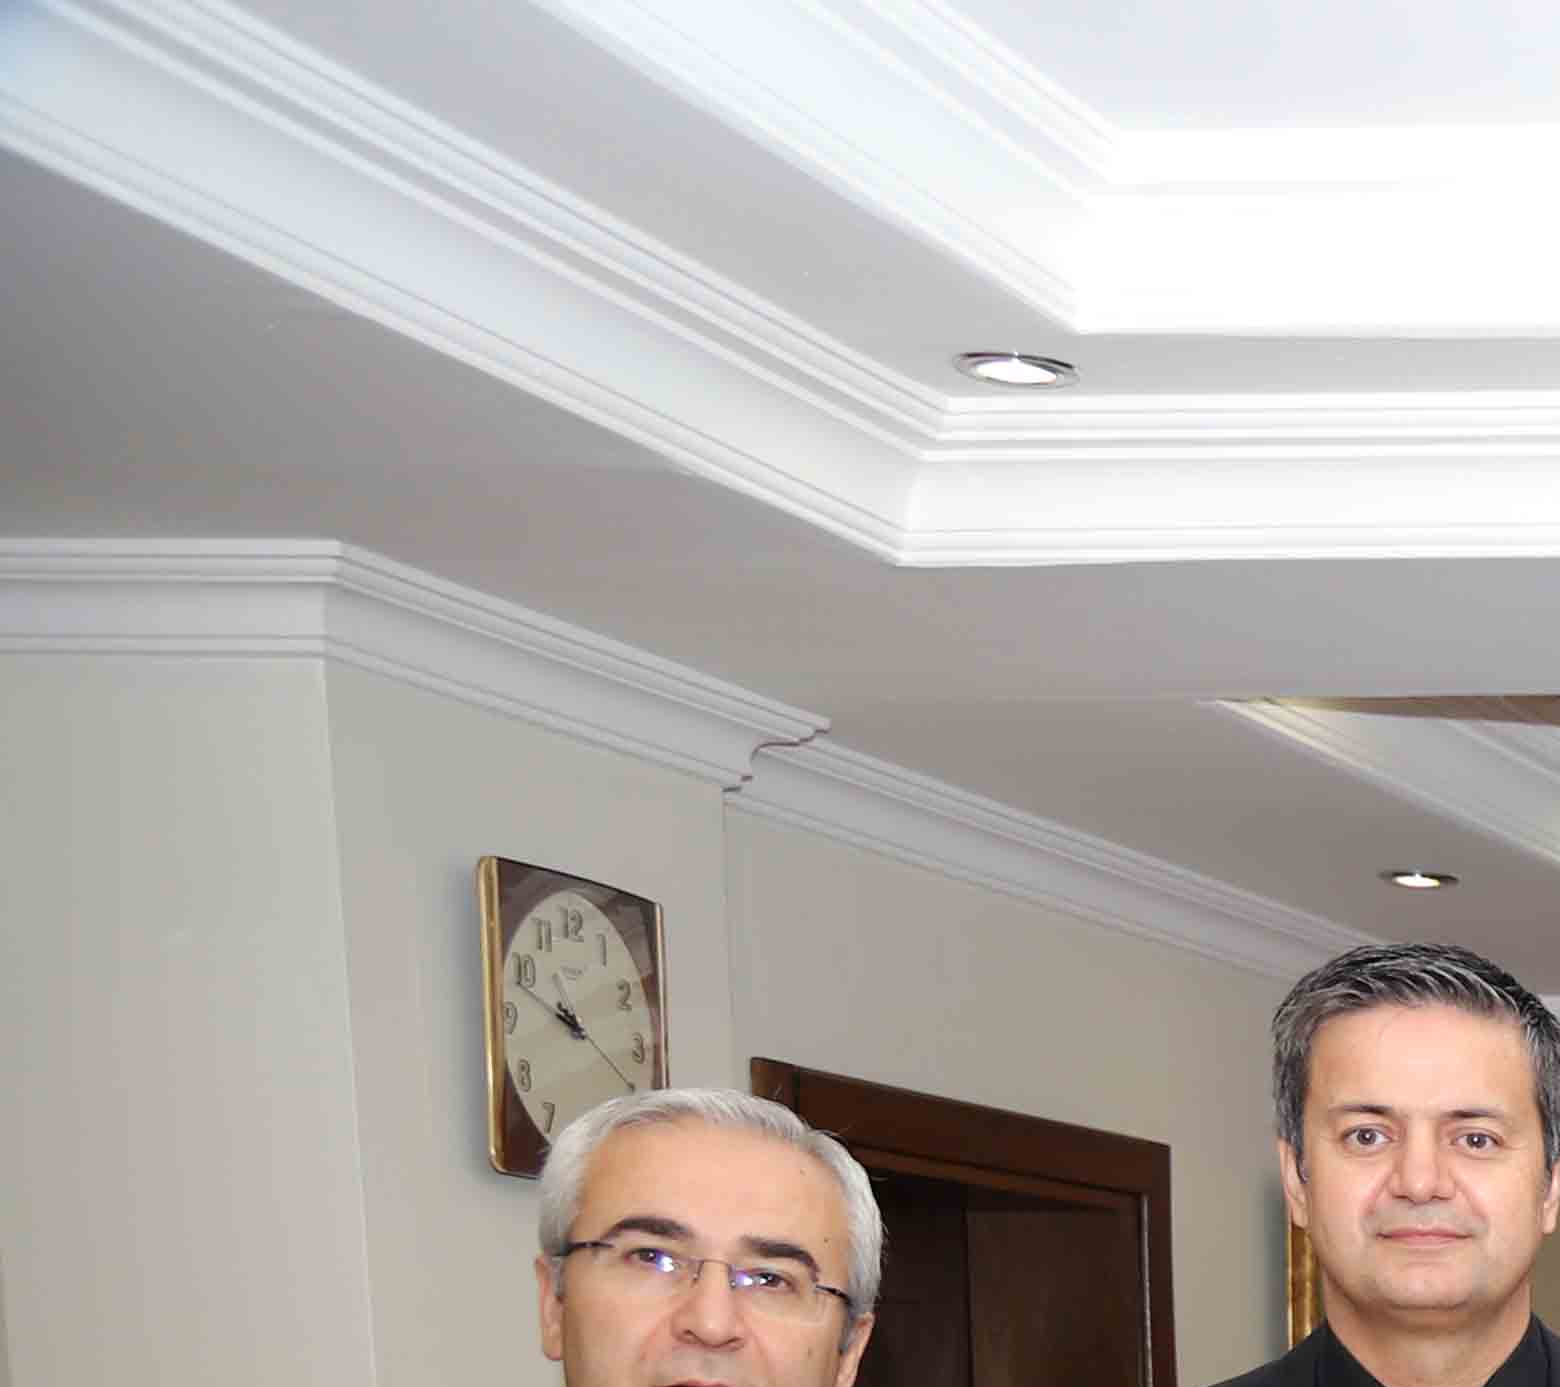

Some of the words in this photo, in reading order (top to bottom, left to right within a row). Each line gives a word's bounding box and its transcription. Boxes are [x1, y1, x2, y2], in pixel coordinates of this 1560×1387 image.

[531, 918, 553, 953] 11
[560, 907, 584, 943] 12
[597, 932, 607, 967] 1
[512, 951, 536, 988] 10
[616, 978, 632, 1011] 2
[503, 1001, 518, 1034] 9
[632, 1032, 645, 1064] 3
[518, 1058, 531, 1092] 8
[542, 1101, 555, 1134] 7
